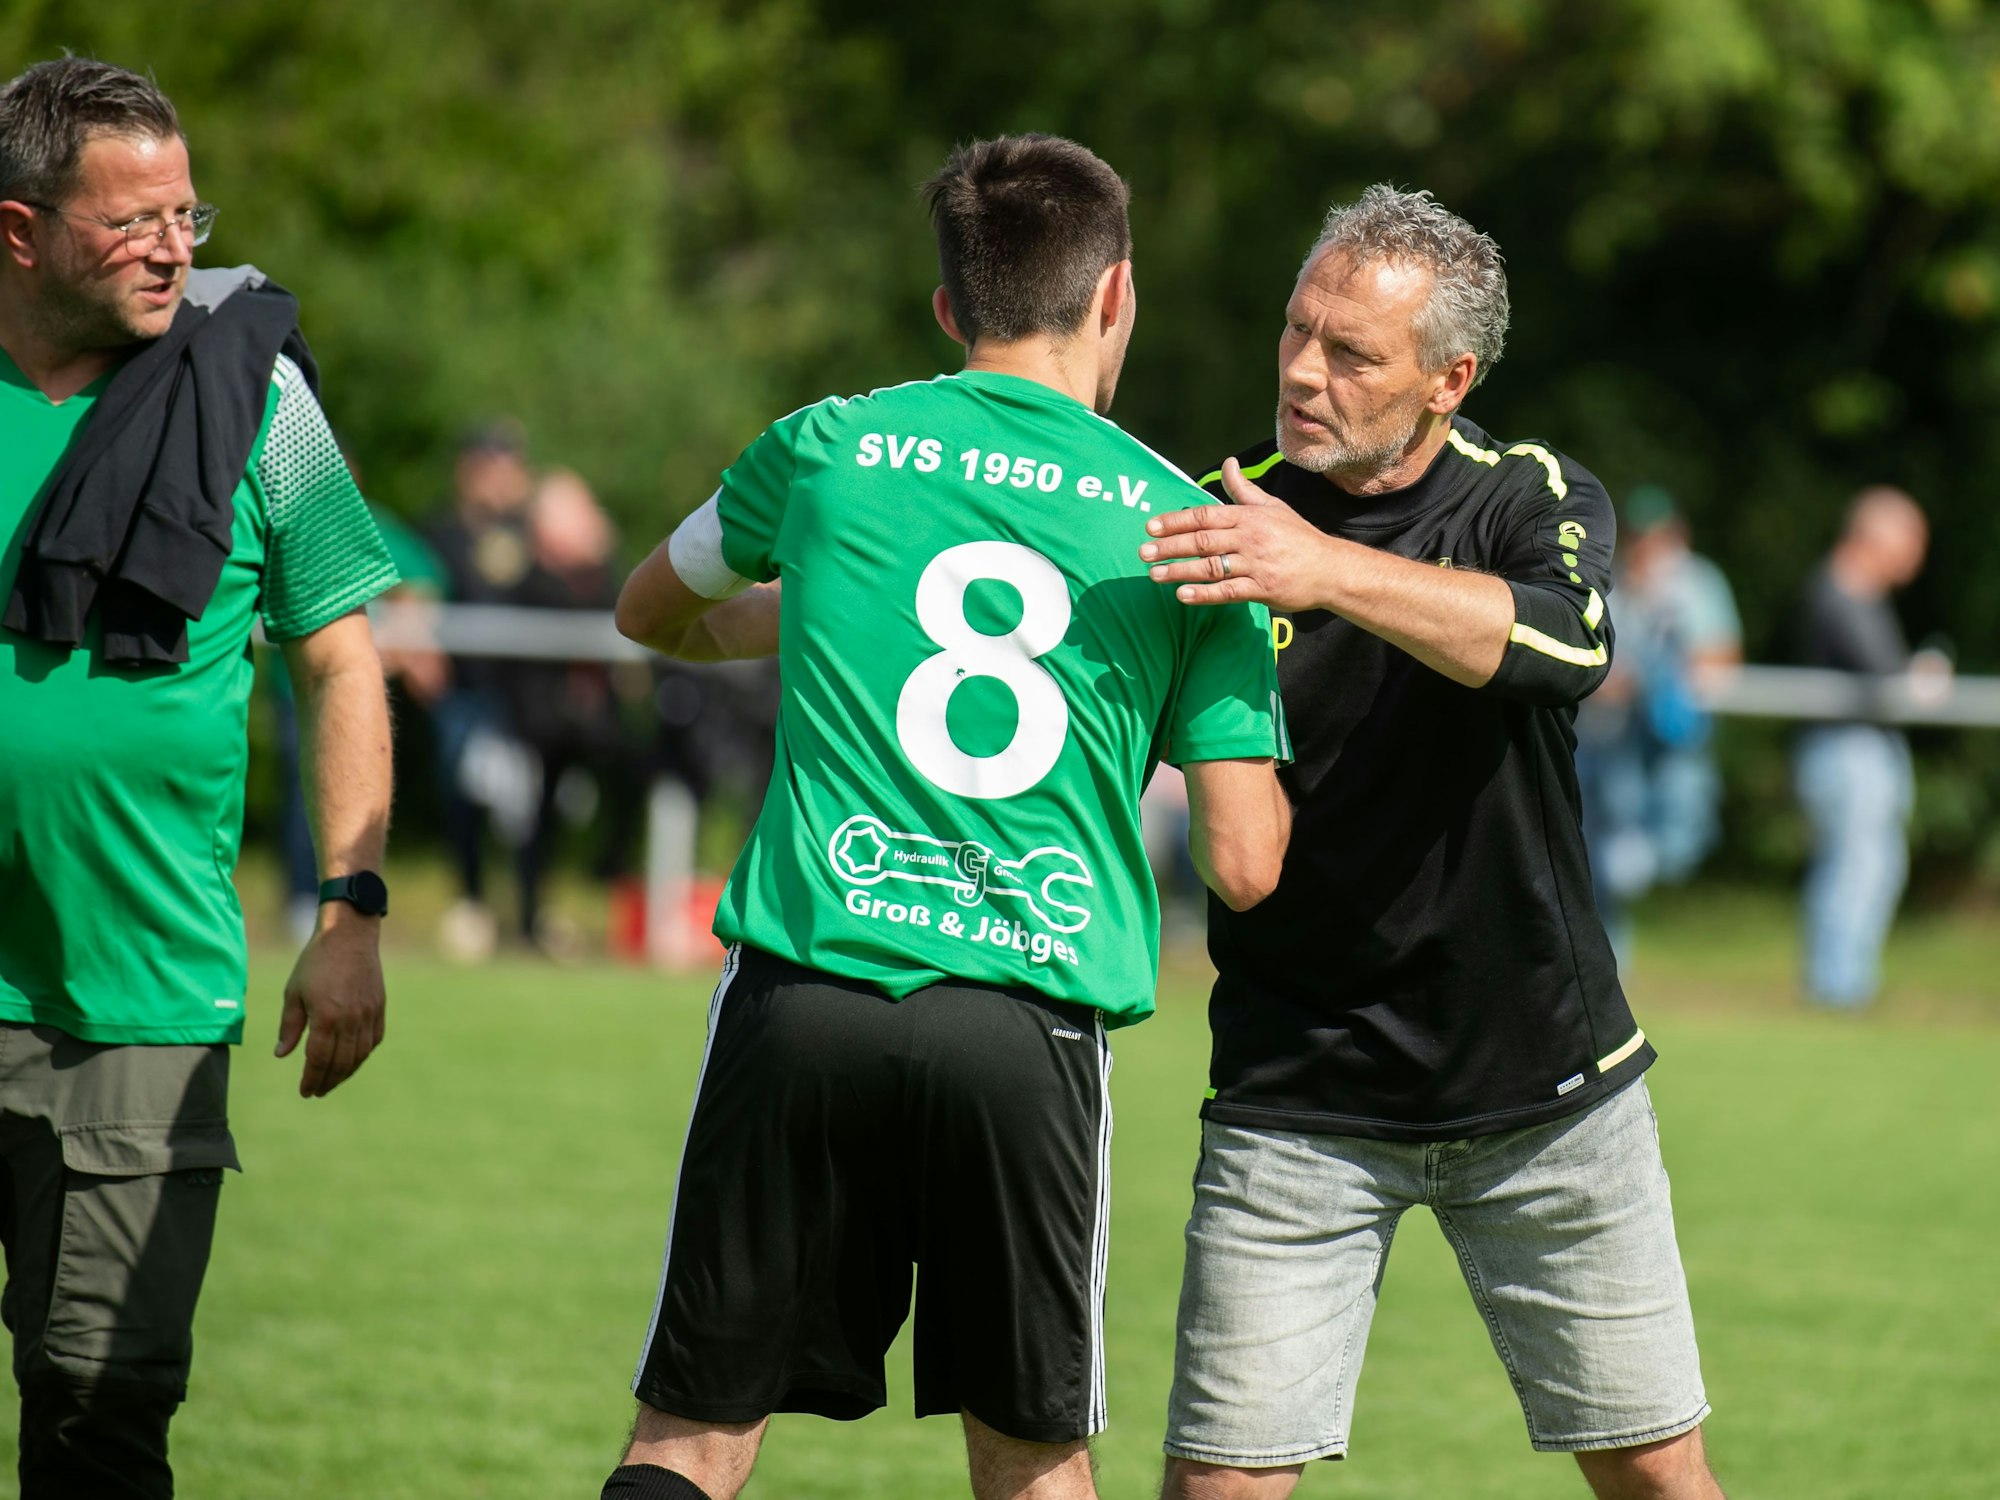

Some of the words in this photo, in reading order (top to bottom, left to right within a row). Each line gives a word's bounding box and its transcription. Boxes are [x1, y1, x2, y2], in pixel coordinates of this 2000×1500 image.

[856, 433, 943, 472] SVS
[959, 448, 1063, 493] 1950
[1076, 475, 1151, 512] e.V.
[896, 540, 1072, 800] 8
[894, 850, 949, 867] Hydraulik
[994, 865, 1024, 886] Gm
[845, 889, 931, 926] Groß
[938, 911, 965, 939] &
[970, 916, 1079, 966] Jöbges
